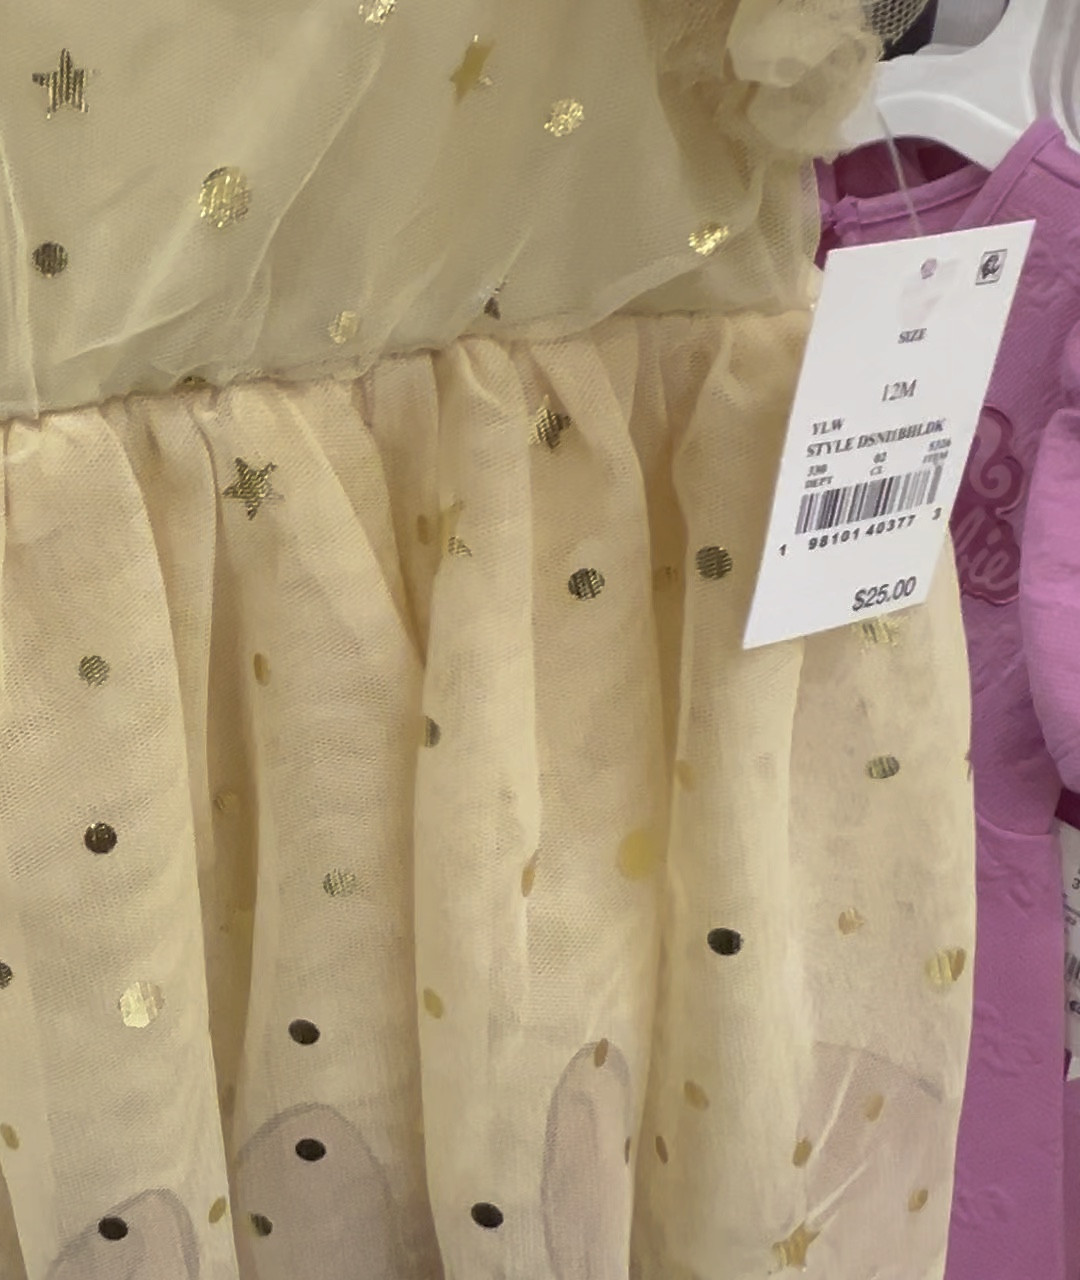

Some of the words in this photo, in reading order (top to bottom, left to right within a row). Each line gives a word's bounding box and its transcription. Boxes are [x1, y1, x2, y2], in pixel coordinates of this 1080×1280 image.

[898, 328, 927, 344] SIZE
[881, 379, 917, 401] 12M
[812, 418, 845, 435] YLW
[806, 436, 856, 458] STYLE
[804, 476, 834, 489] DEPT
[778, 544, 787, 557] 1
[808, 528, 860, 550] 98101
[865, 514, 916, 536] 40377
[932, 507, 942, 520] 3
[852, 576, 917, 611] $25.00
